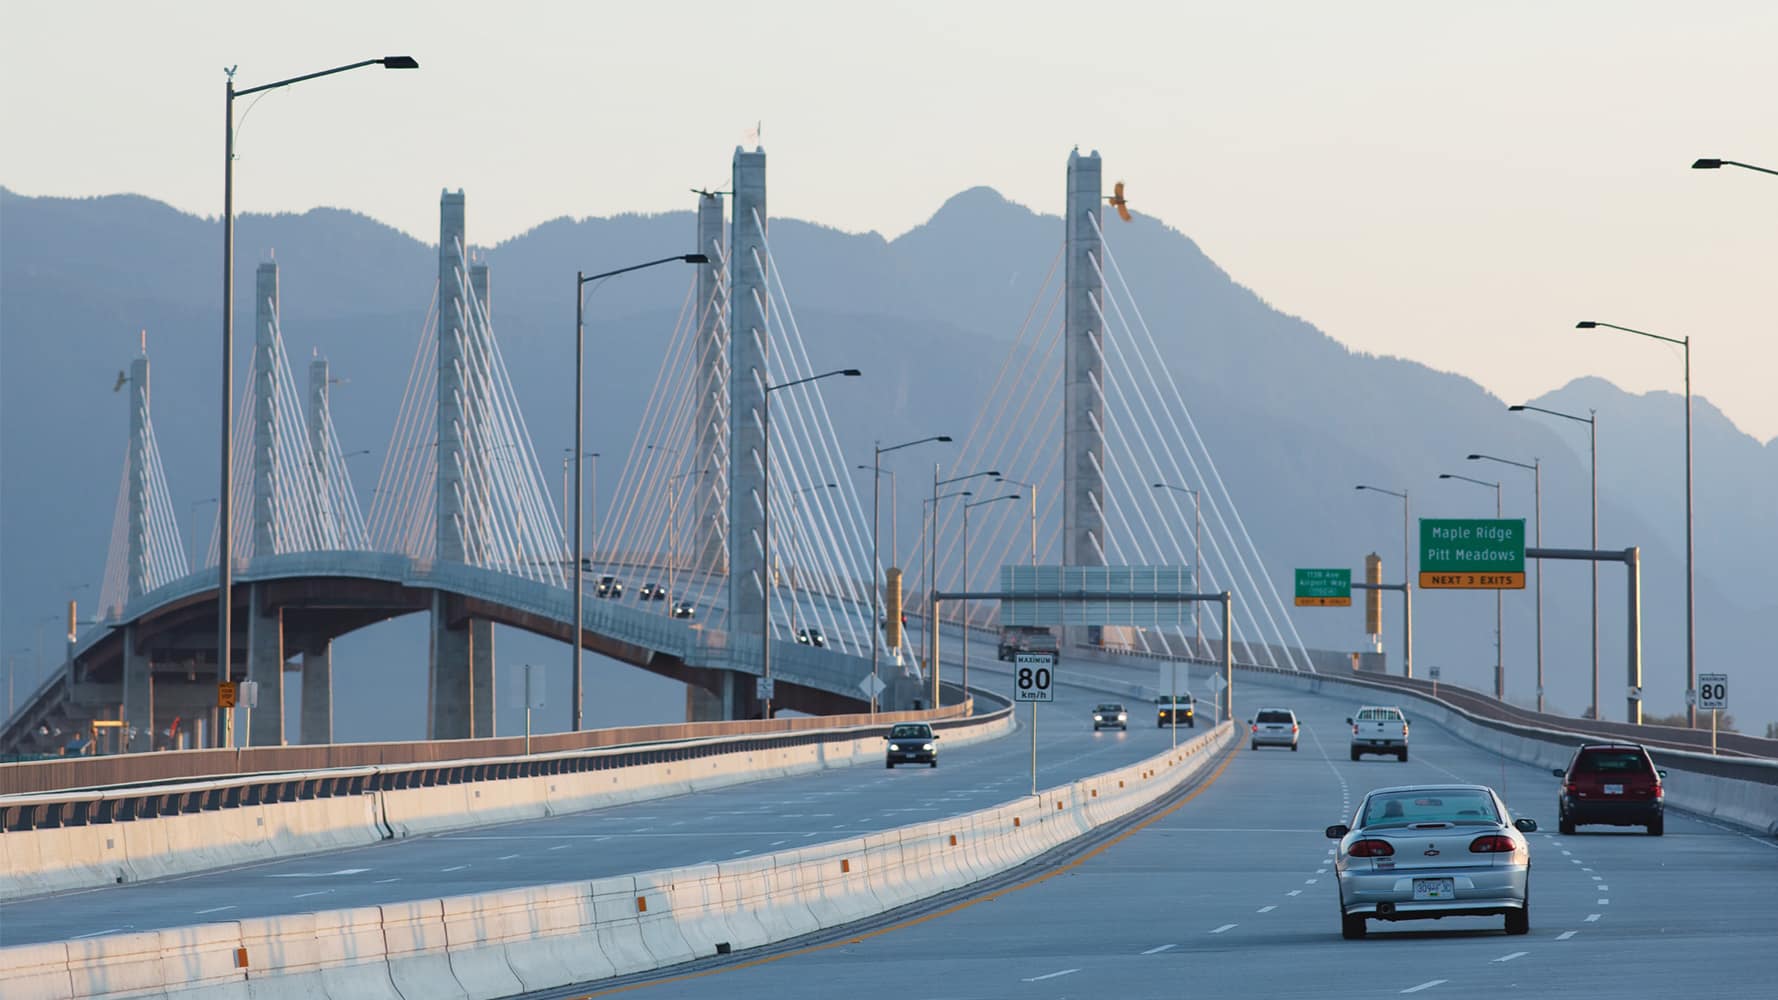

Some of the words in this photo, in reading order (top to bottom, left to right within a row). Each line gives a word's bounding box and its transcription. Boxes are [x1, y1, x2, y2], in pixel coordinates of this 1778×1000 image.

[1432, 526, 1471, 541] Maple
[1476, 526, 1512, 541] Ridge
[1428, 548, 1450, 561] Pitt
[1456, 548, 1515, 561] Meadows
[1432, 576, 1461, 585] NEXT
[1467, 576, 1475, 585] 3
[1480, 576, 1513, 585] EXITS
[1018, 667, 1050, 690] 80
[1022, 691, 1046, 699] km/h
[1702, 684, 1725, 700] 80
